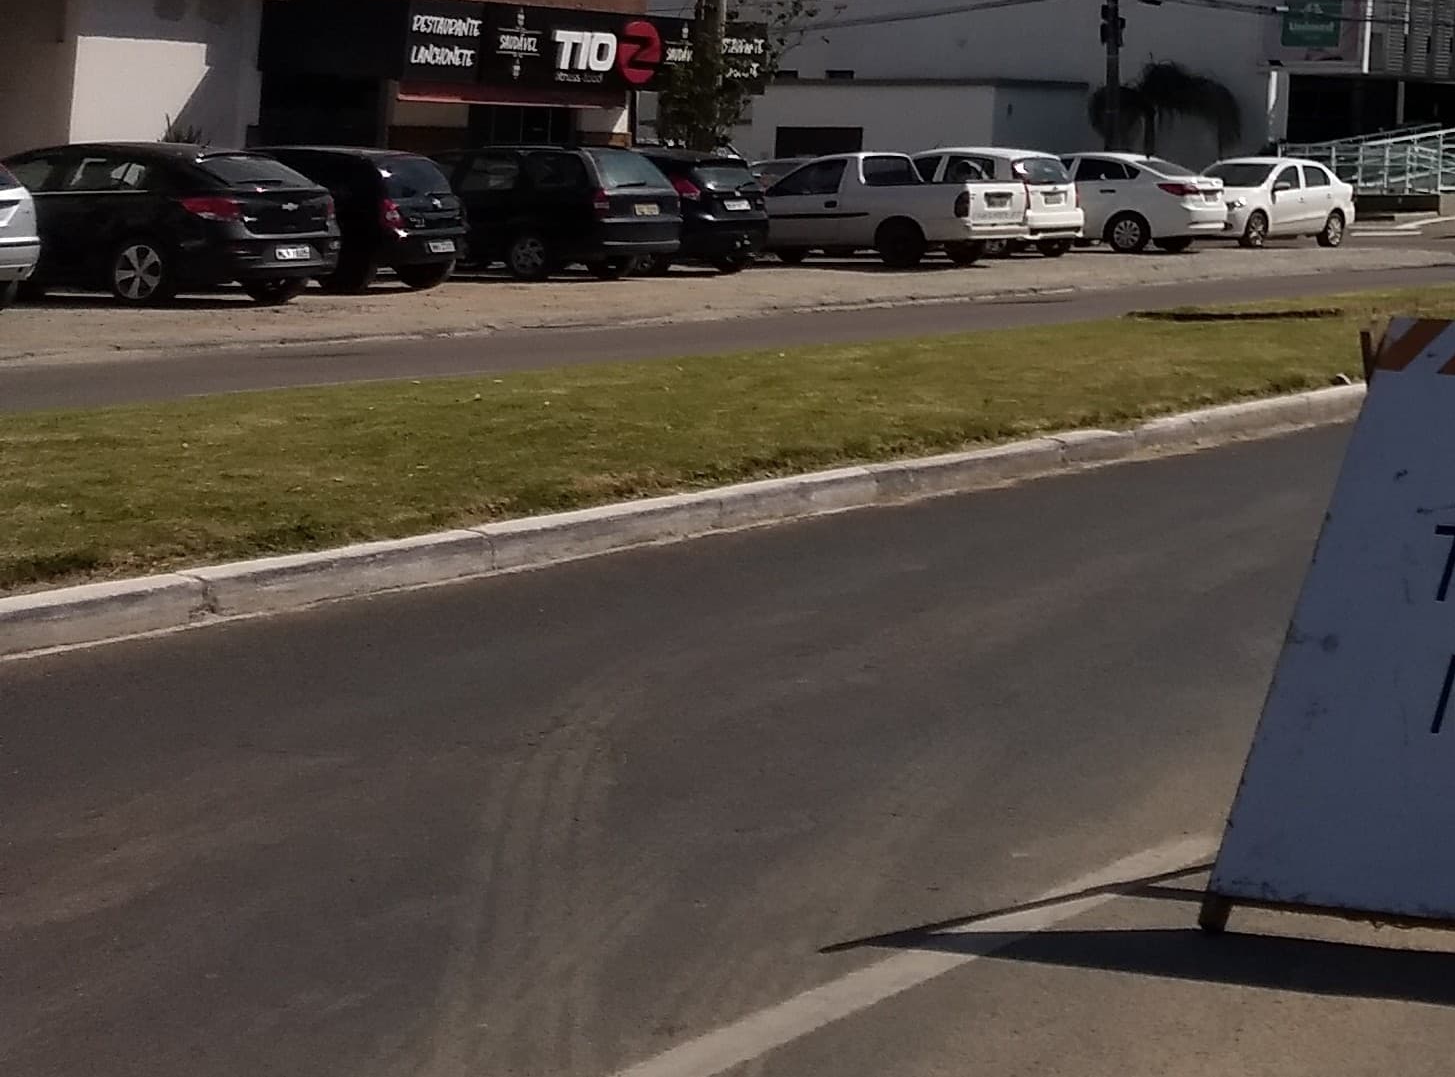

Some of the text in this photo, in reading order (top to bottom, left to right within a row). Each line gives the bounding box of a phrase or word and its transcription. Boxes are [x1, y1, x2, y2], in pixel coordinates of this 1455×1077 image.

[411, 14, 483, 37] RESTAURANTE
[410, 44, 477, 67] LANCHONETE
[499, 35, 539, 53] SAUDÁVEL
[552, 29, 618, 72] TIO
